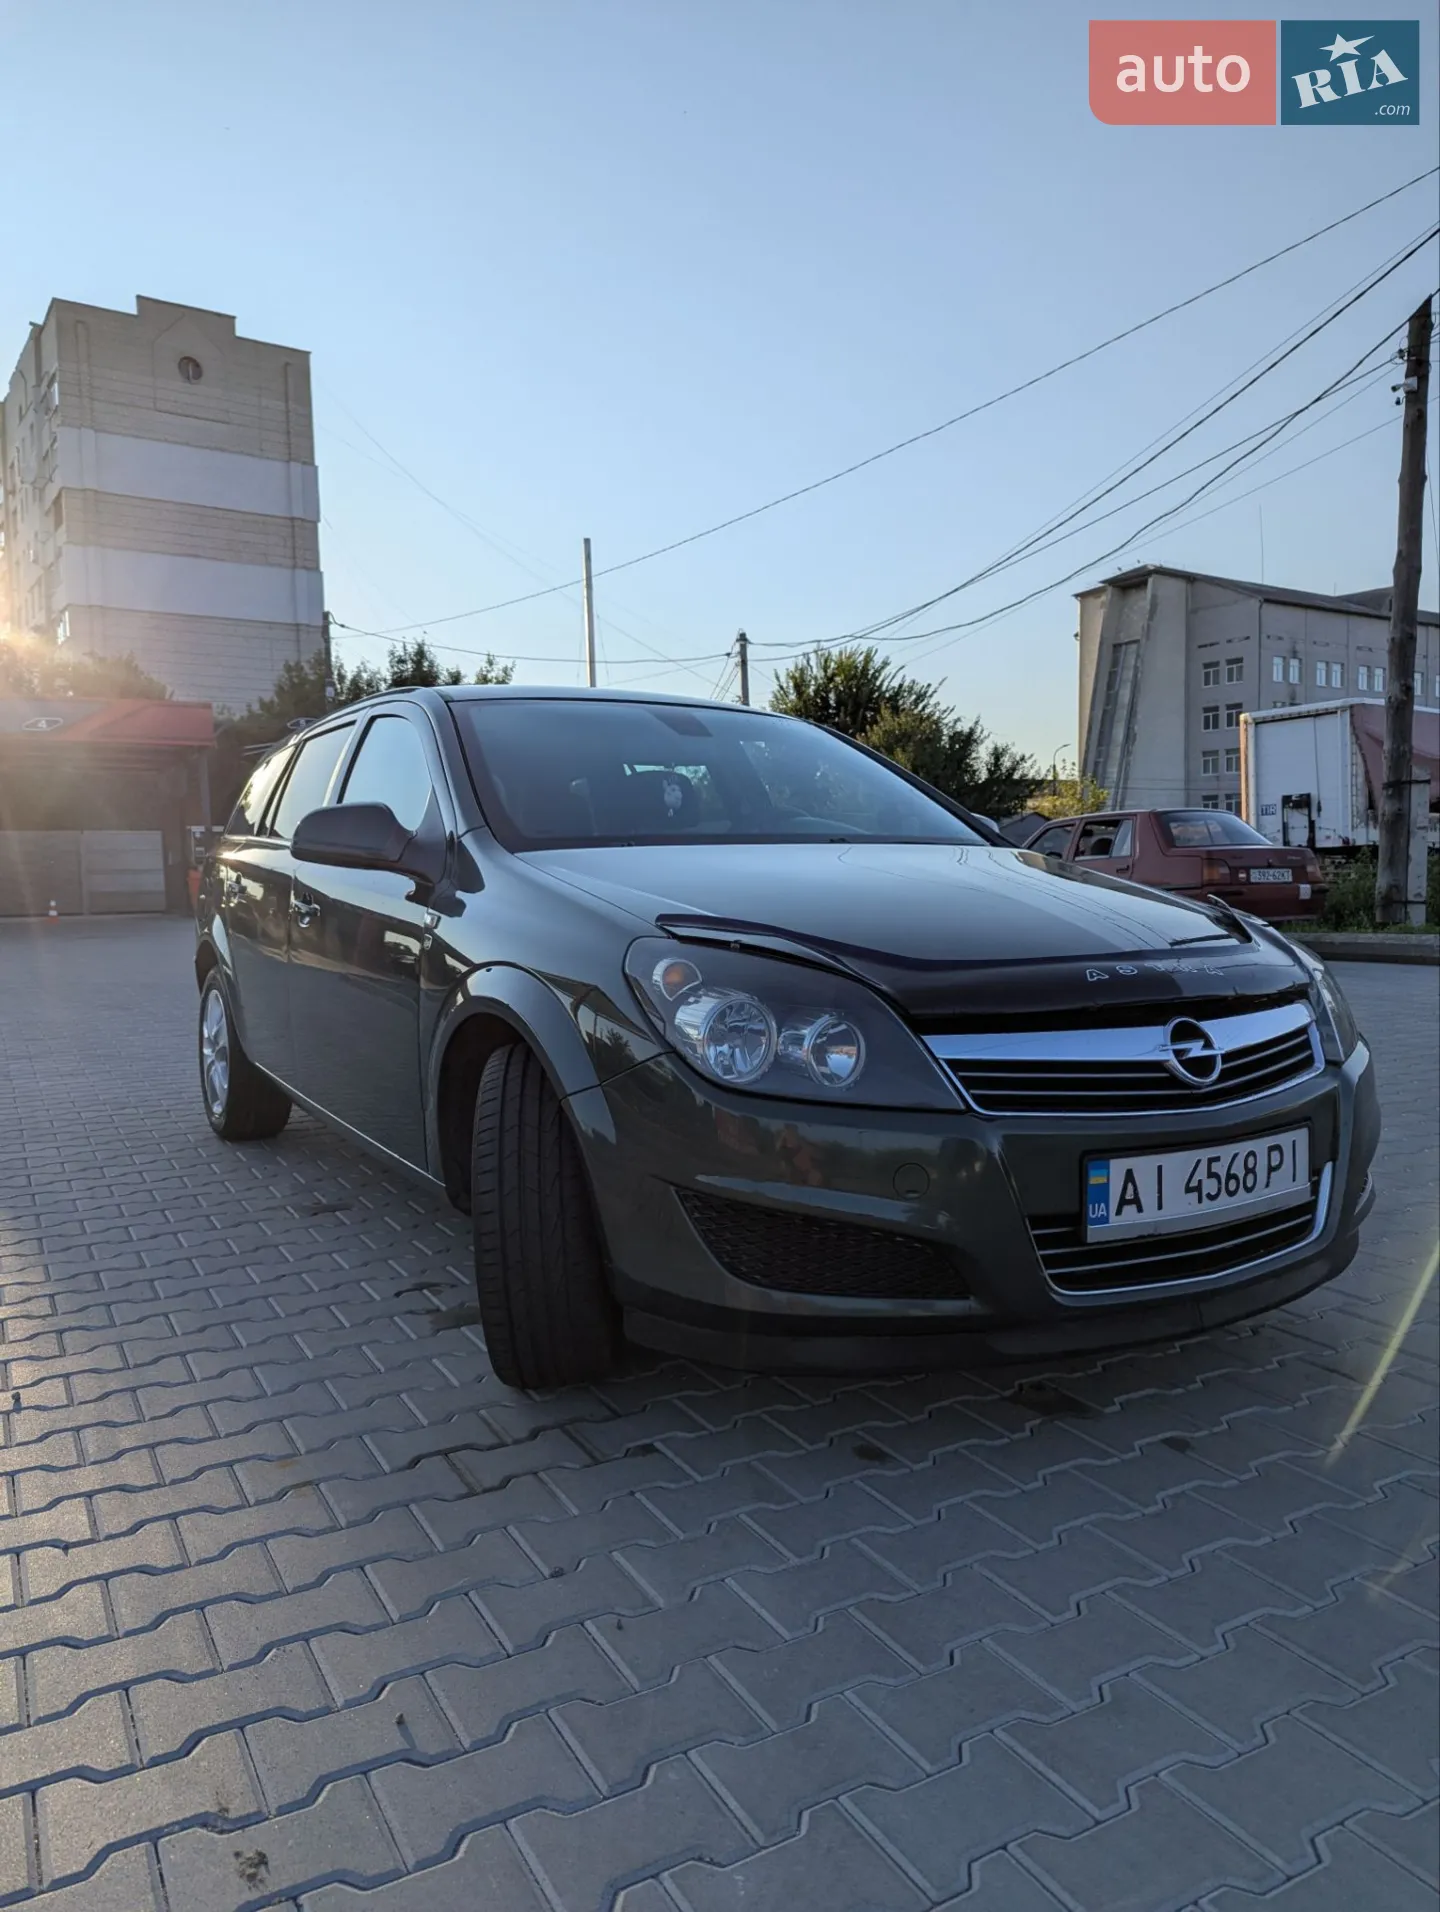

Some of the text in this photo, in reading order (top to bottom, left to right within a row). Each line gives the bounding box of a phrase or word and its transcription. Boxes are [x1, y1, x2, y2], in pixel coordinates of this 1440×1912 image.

[1261, 804, 1276, 816] TIR
[1115, 1139, 1297, 1217] AI 4568 PI
[1089, 1203, 1108, 1218] UA
